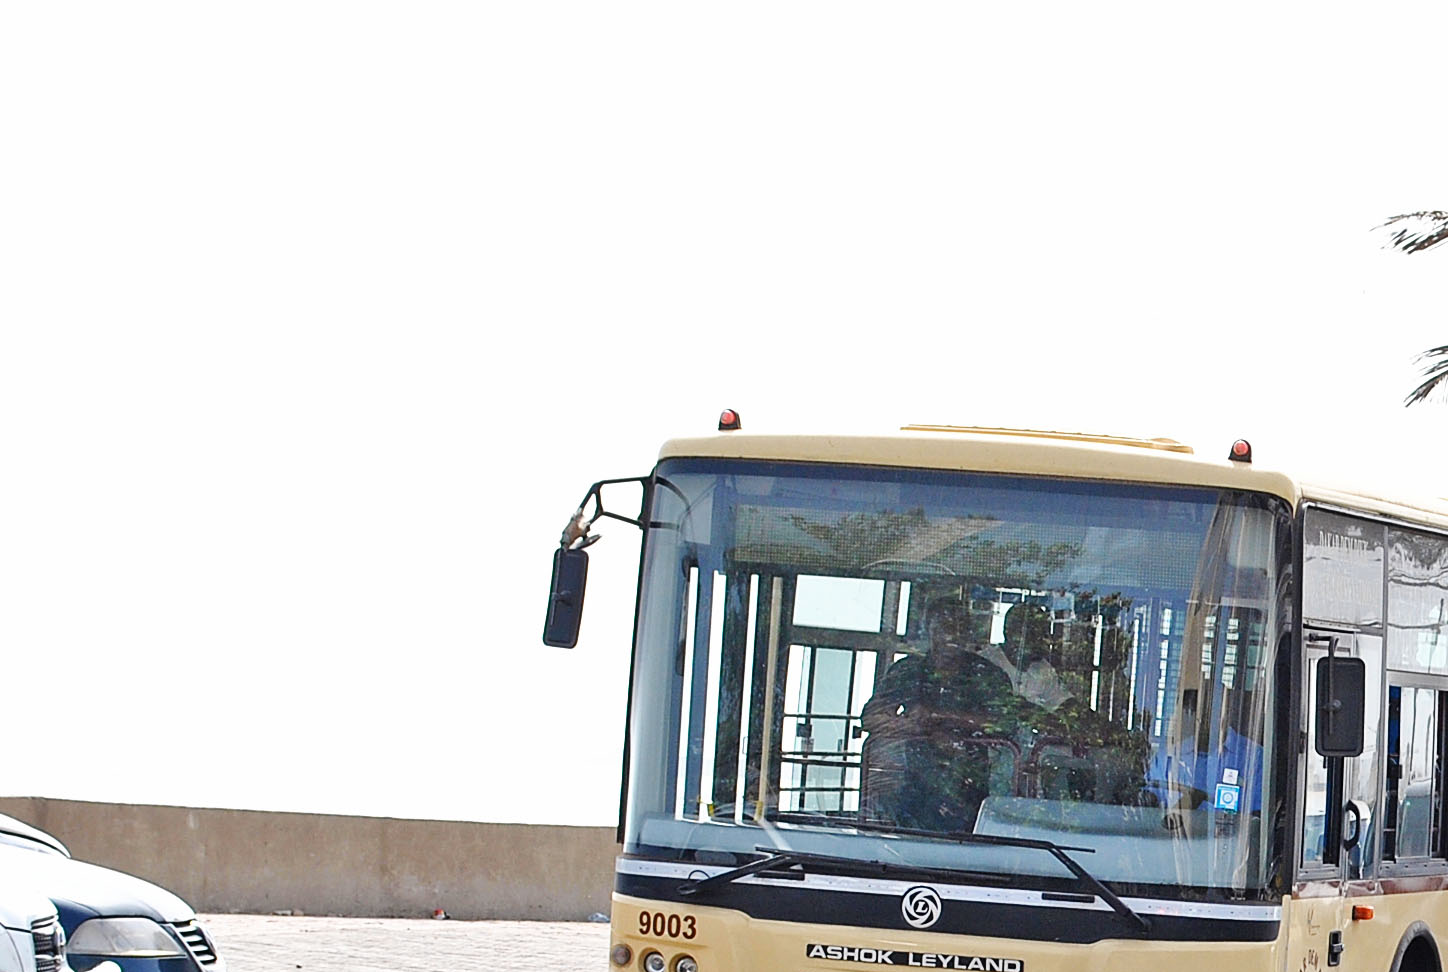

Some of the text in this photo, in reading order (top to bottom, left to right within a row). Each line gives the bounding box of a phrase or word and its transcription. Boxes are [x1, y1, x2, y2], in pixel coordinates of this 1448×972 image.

[915, 901, 928, 913] L
[639, 910, 697, 940] 9003
[809, 944, 894, 964] ASHOK
